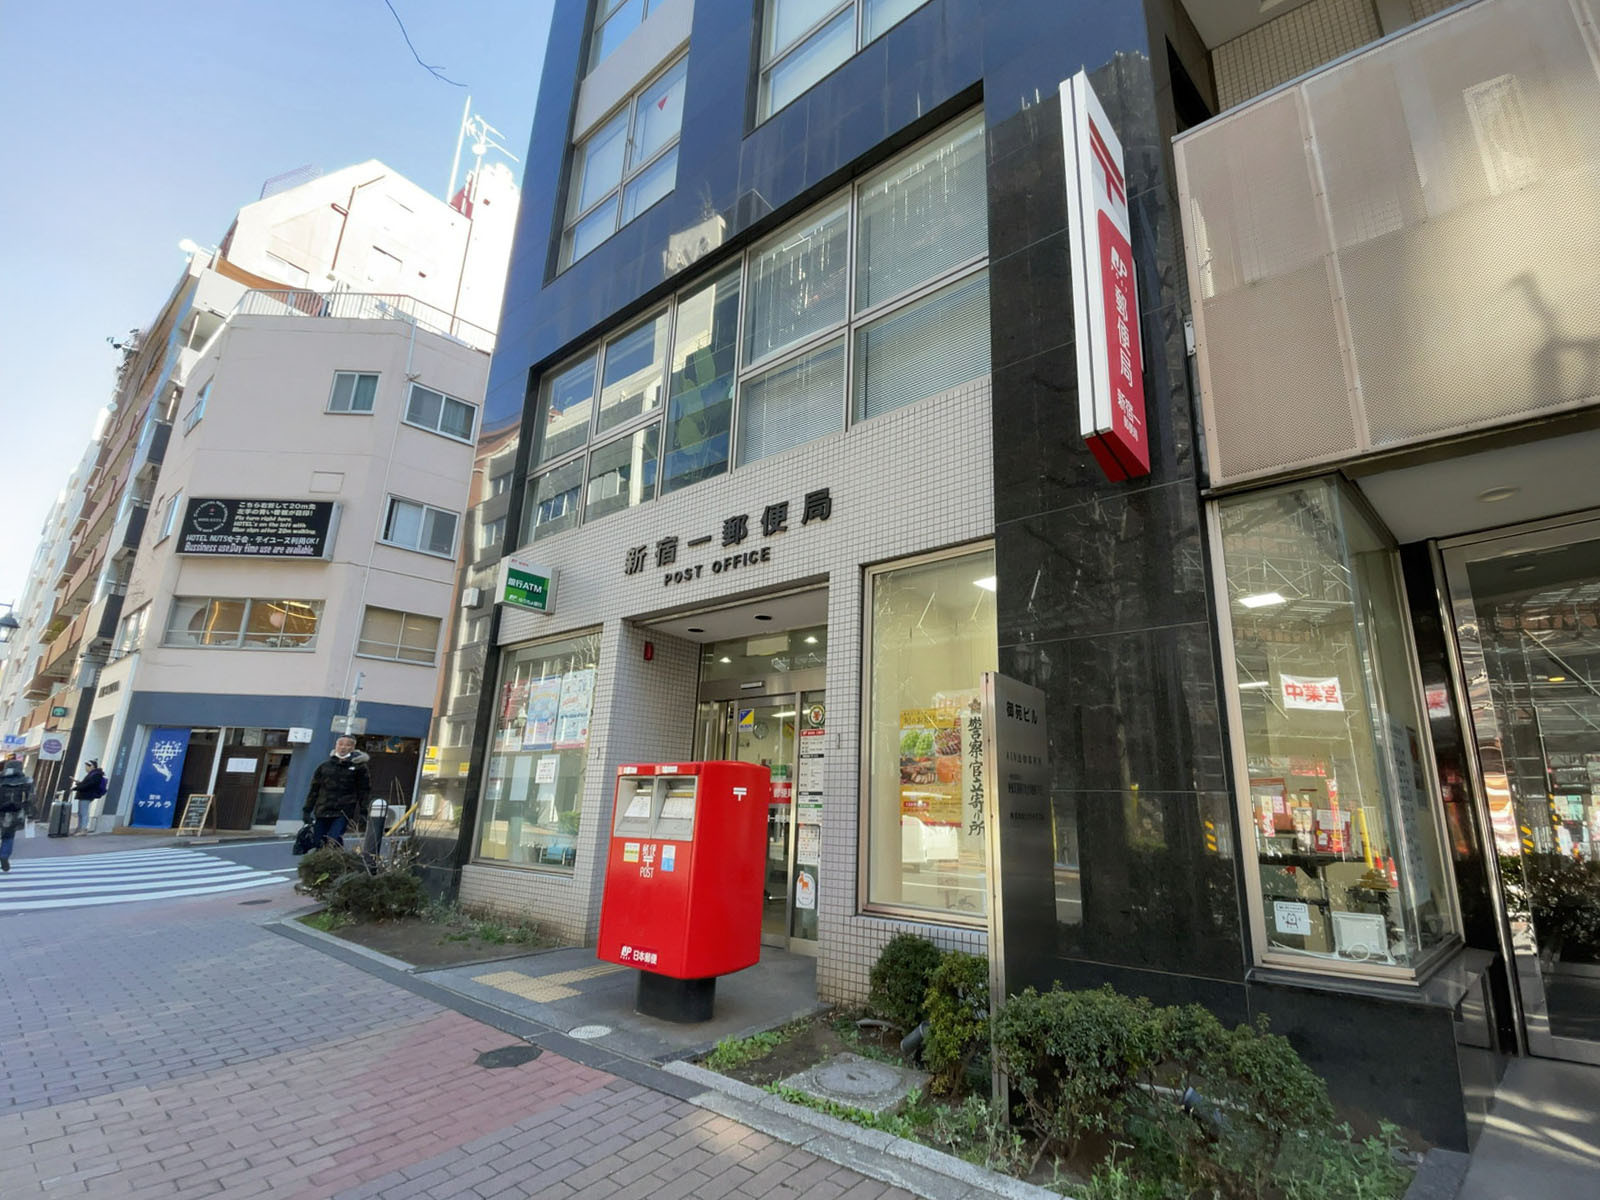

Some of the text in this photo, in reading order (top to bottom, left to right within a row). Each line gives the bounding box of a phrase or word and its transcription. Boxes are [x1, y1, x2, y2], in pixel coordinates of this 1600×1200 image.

[1114, 284, 1133, 388] 郵便局
[624, 487, 832, 576] 新宿一郵便局
[244, 544, 259, 554] time
[260, 545, 271, 554] use
[272, 546, 284, 554] are
[664, 546, 772, 586] POST OFFICE
[508, 577, 542, 594] 銀行ATM
[968, 716, 986, 836] 警察官立寄り所
[640, 866, 654, 878] POST
[633, 950, 657, 965] 日本郵便
